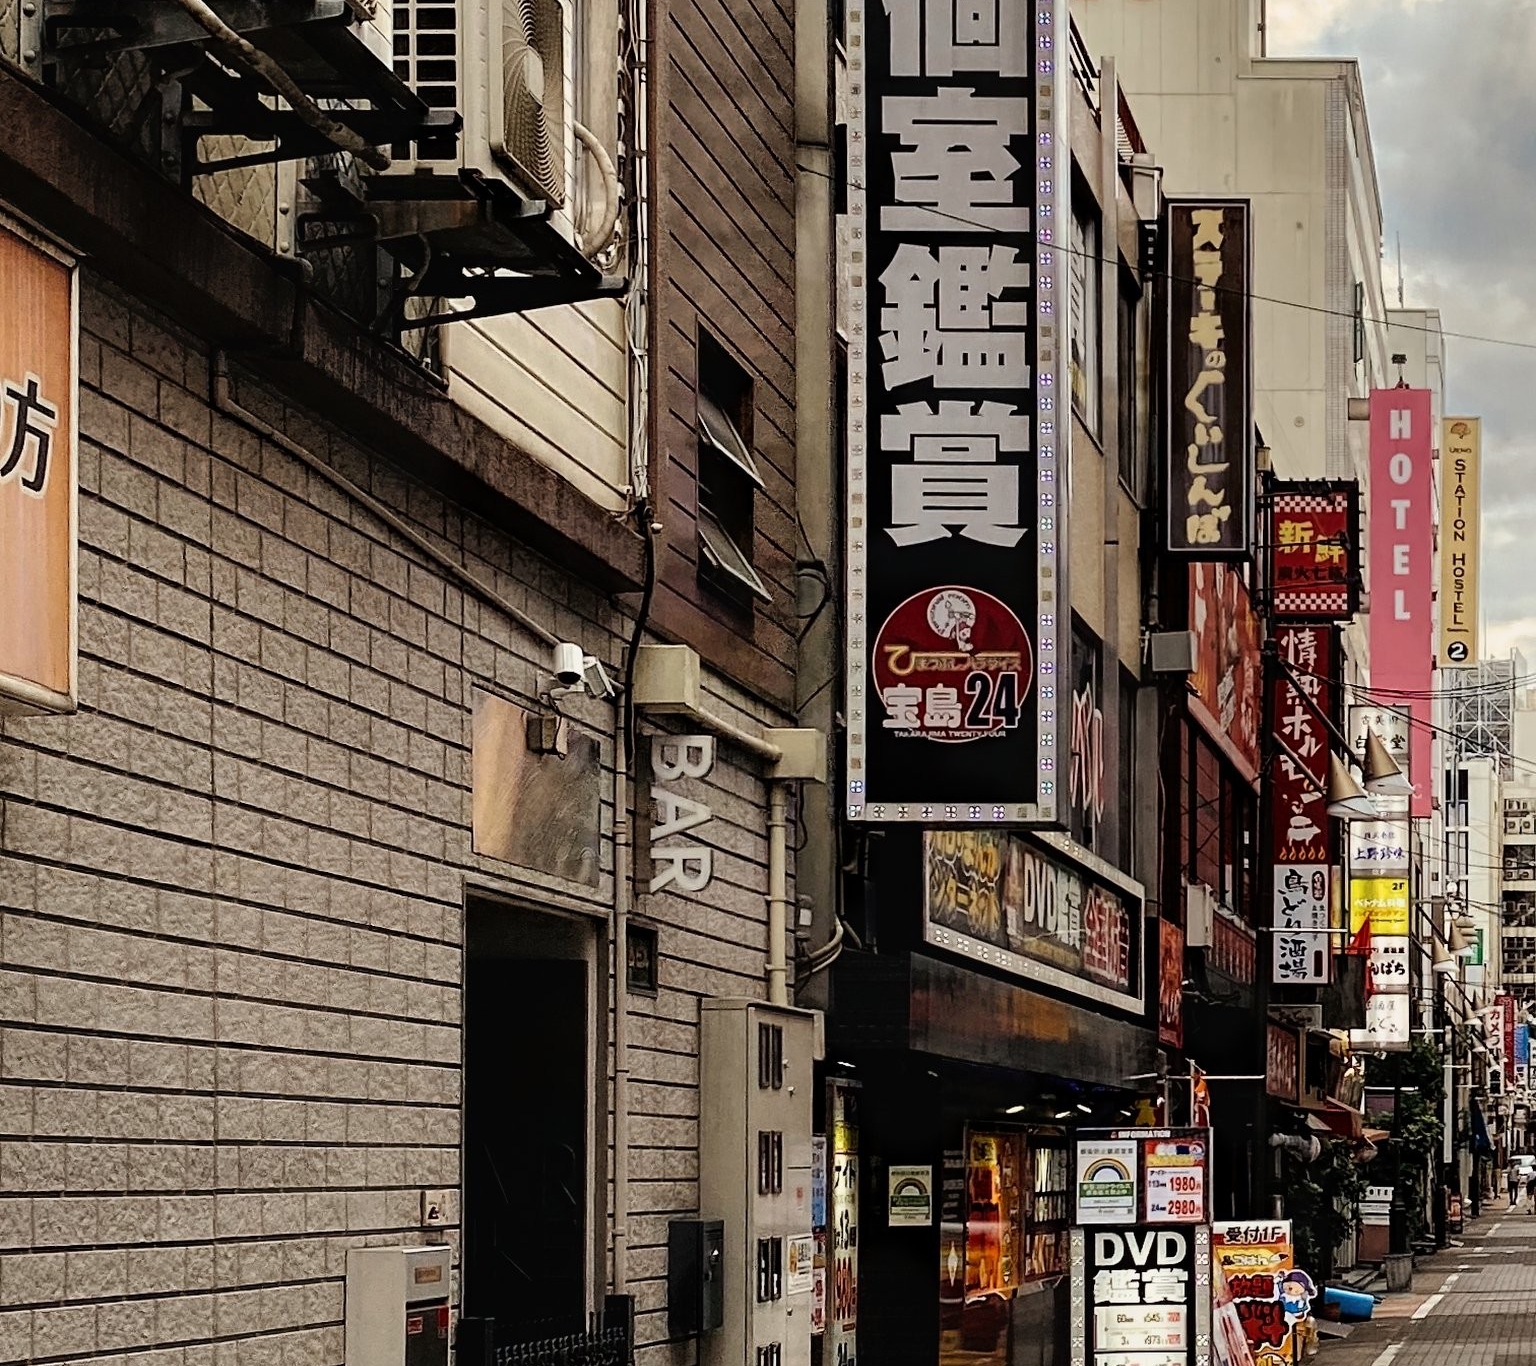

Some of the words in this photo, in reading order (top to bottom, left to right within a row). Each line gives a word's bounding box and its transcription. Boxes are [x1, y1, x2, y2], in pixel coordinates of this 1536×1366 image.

[1389, 409, 1412, 621] HOTEL
[1453, 459, 1466, 542] STATION
[1279, 519, 1345, 564] 新鮮
[1452, 553, 1466, 626] HOSTEL
[1449, 643, 1466, 660] 2
[882, 671, 1022, 729] 宝島24
[650, 734, 717, 895] BAR
[1094, 1231, 1187, 1266] DVD
[1225, 1226, 1283, 1244] 受付1F
[1093, 1267, 1189, 1305] 鑑賞
